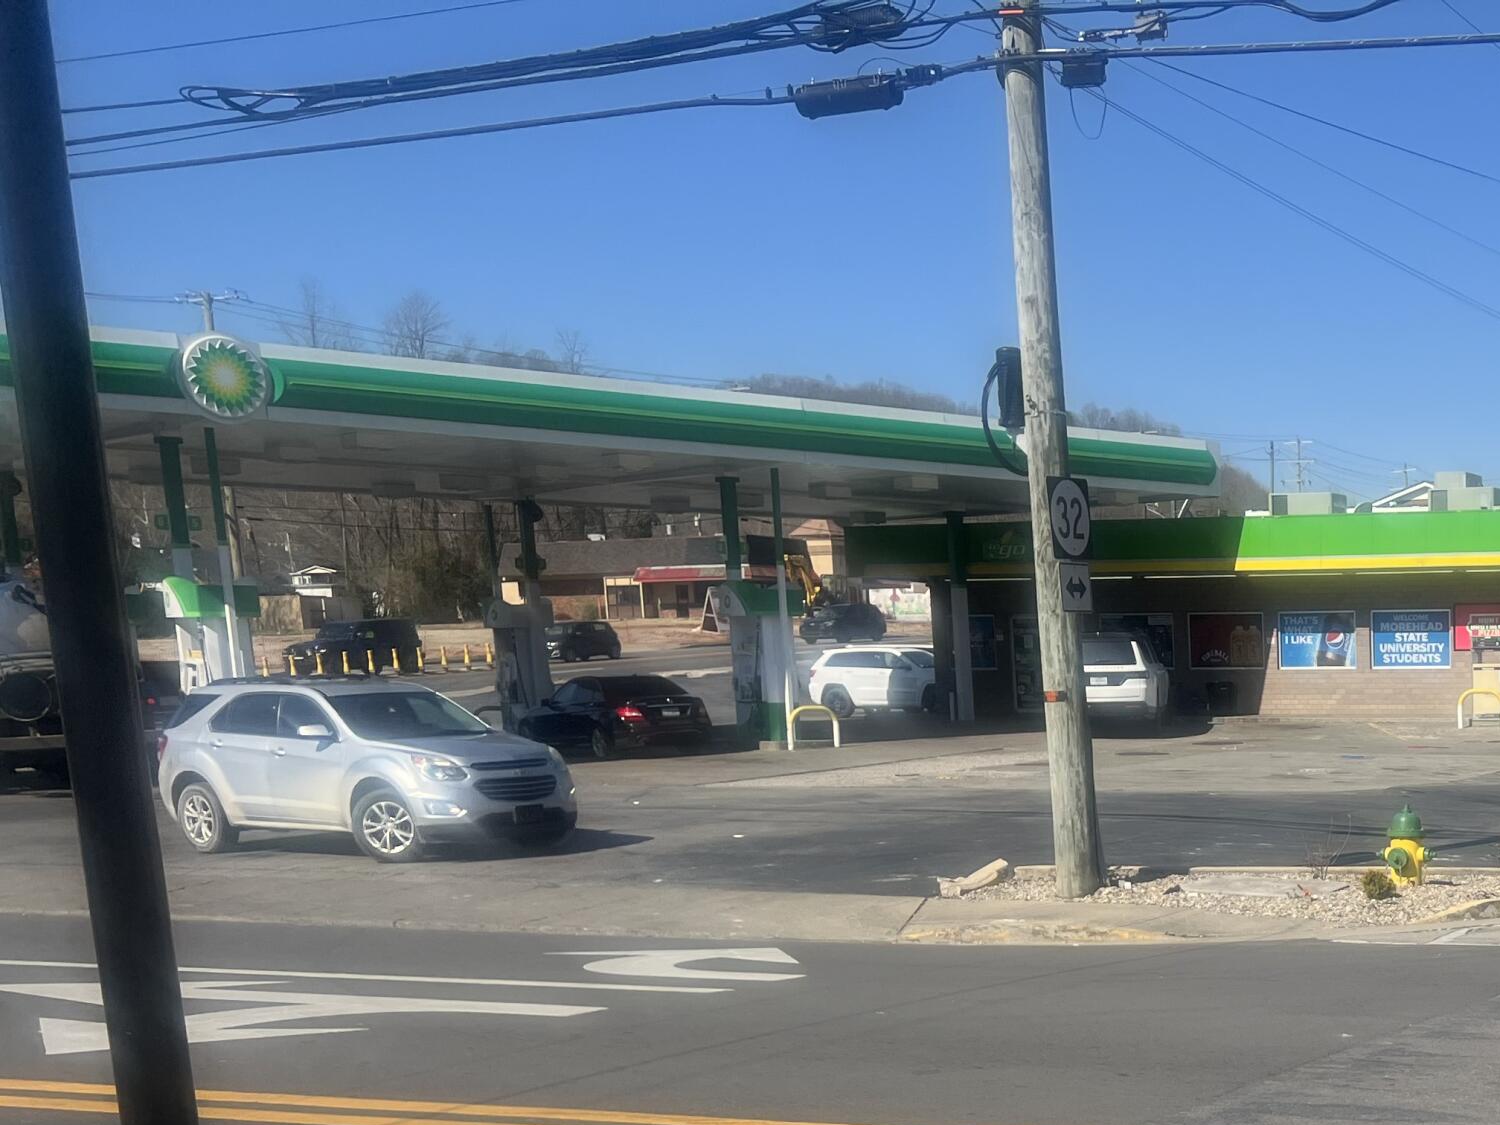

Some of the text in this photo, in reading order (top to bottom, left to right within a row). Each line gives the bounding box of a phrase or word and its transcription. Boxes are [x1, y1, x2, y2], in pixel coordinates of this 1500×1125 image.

[1056, 495, 1085, 540] 32
[1283, 616, 1319, 625] THAT'S
[1392, 613, 1429, 621] WELCOME
[1284, 625, 1313, 634] WHAT
[1380, 622, 1443, 632] MOREHEAD
[1285, 635, 1313, 644] I LIKE
[1394, 633, 1429, 642] STATE
[1380, 643, 1445, 653] UNIVERSITY
[1382, 653, 1442, 664] STUDENTS
